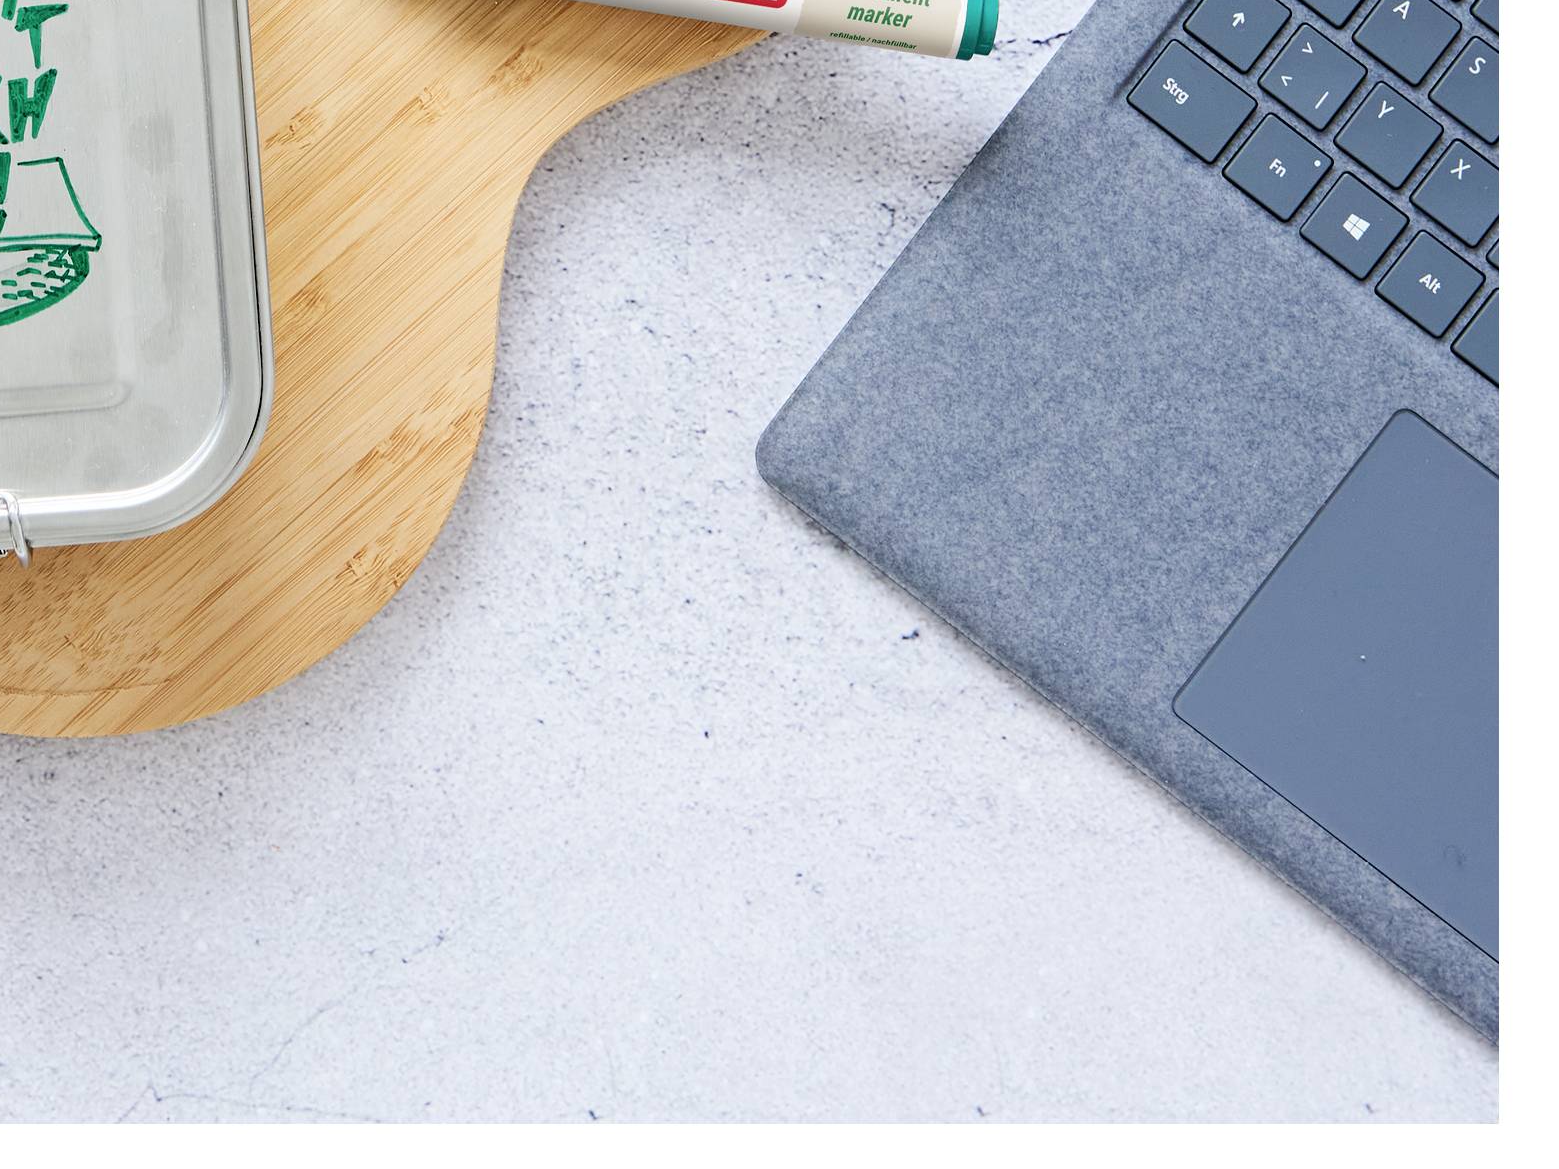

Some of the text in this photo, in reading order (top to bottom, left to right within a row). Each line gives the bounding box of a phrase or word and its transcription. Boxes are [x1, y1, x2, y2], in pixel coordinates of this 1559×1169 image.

[847, 5, 913, 28] marker
[1392, 0, 1411, 20] A
[830, 31, 865, 42] refillable
[872, 37, 917, 50] nachfüllbar
[1468, 57, 1486, 74] S
[1162, 77, 1190, 105] Strg
[1377, 100, 1395, 119] Y
[1269, 158, 1287, 178] Fn
[1450, 158, 1471, 180] X
[1419, 273, 1442, 294] Alt
